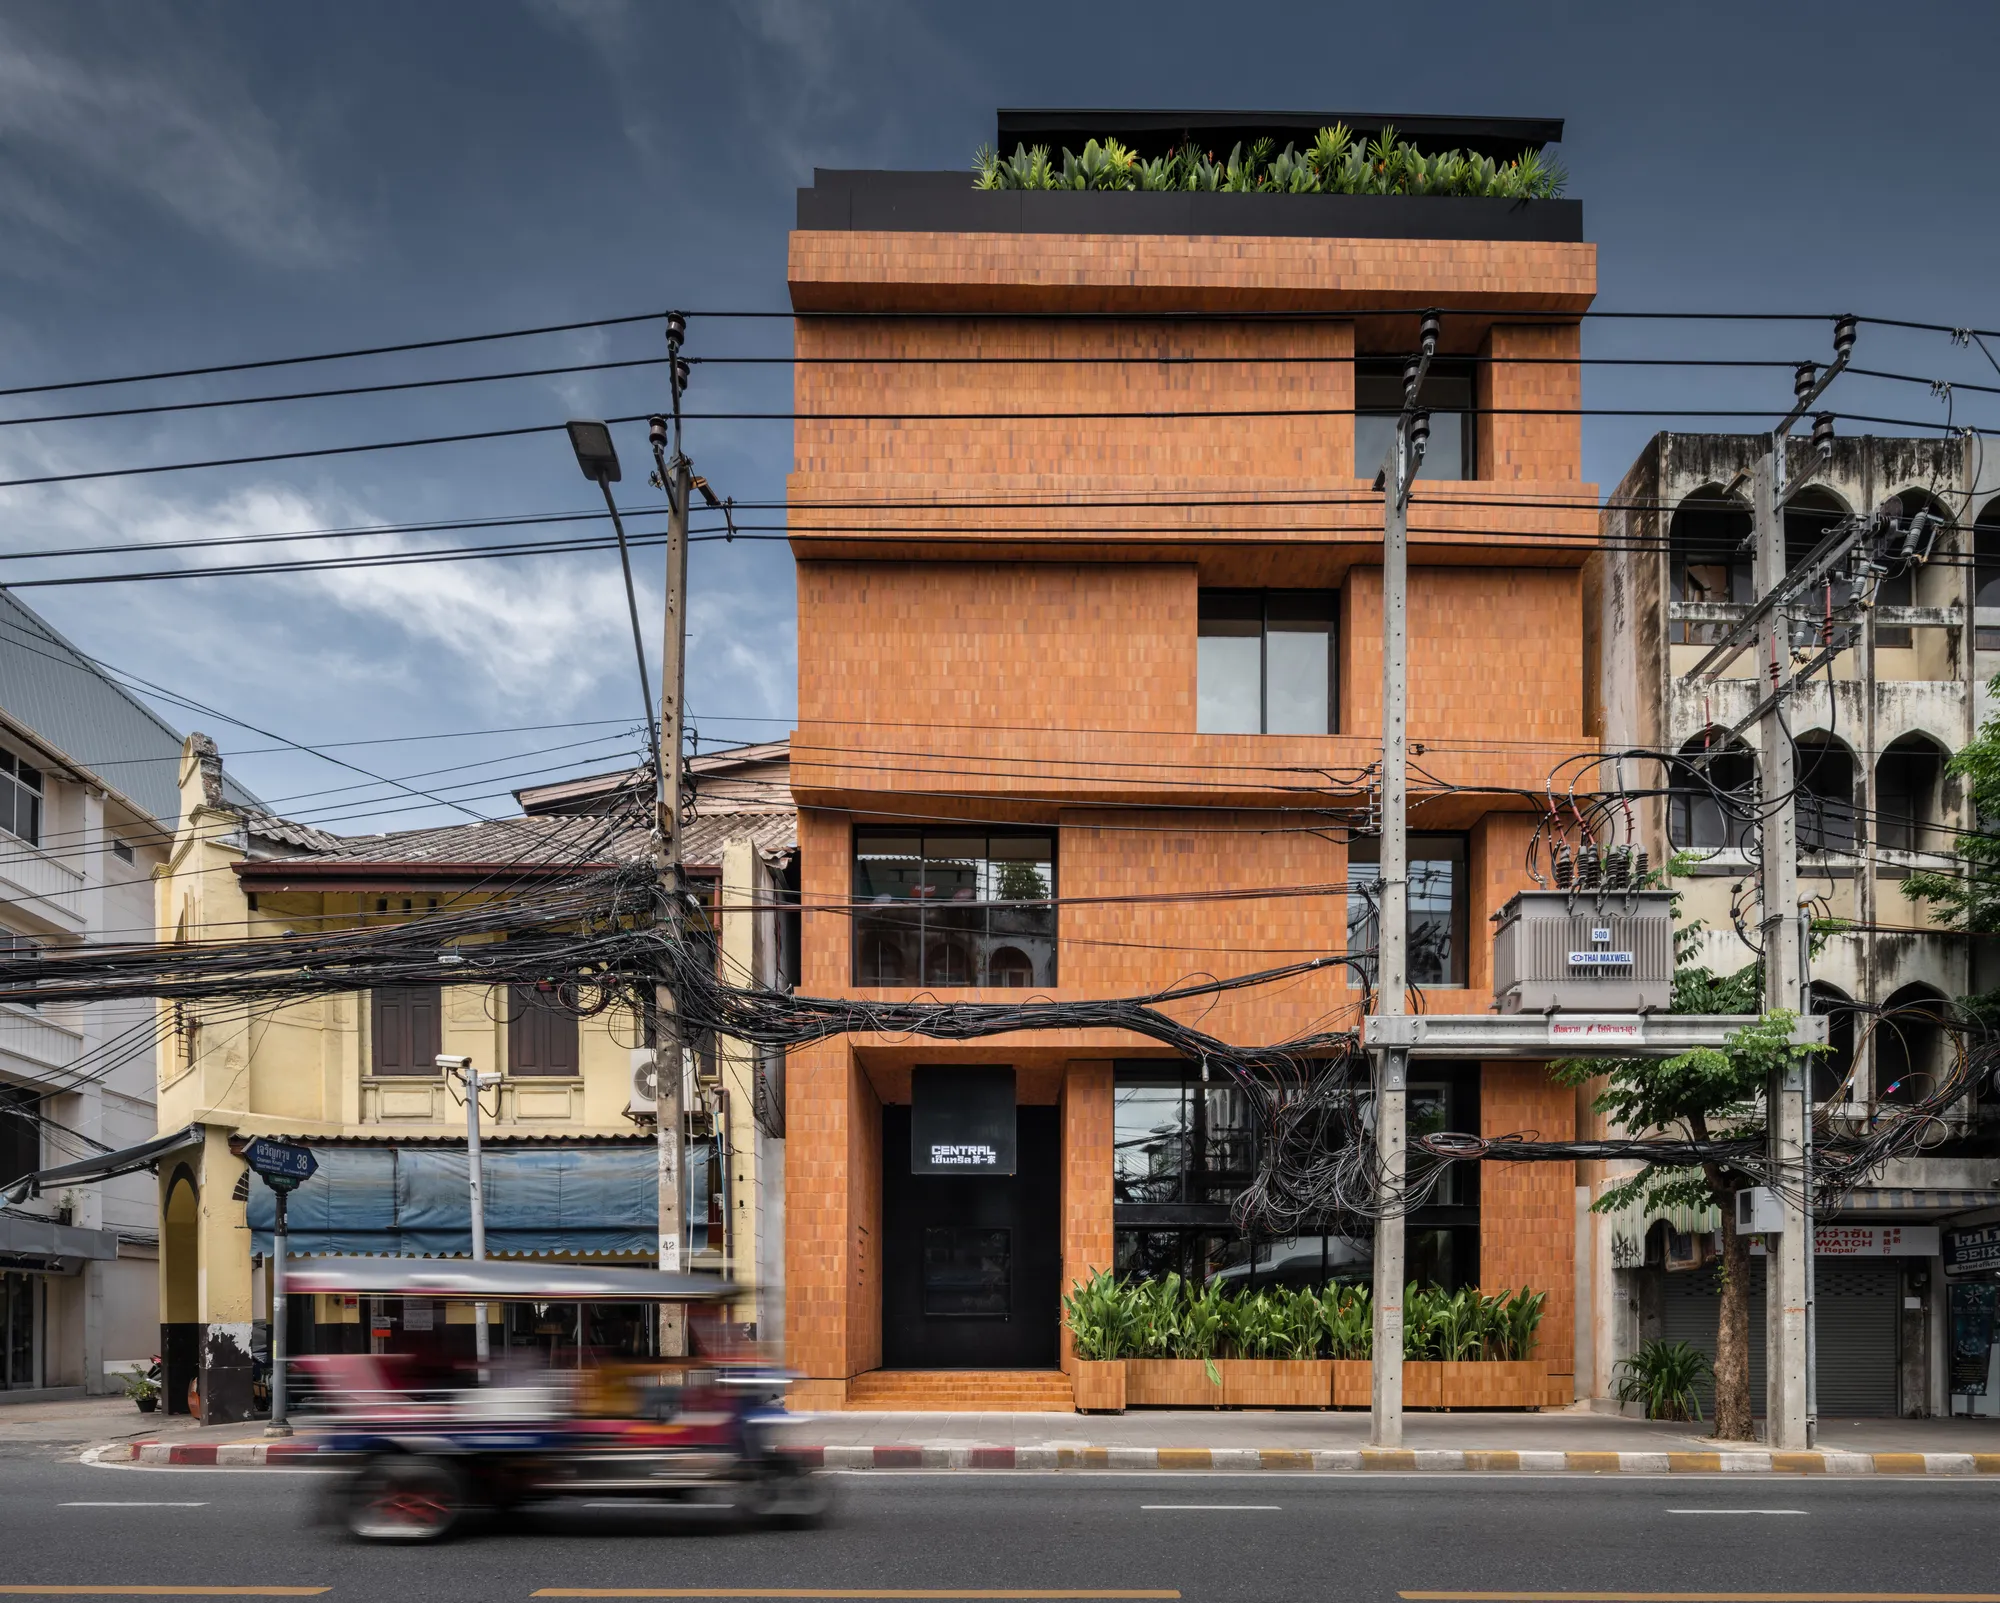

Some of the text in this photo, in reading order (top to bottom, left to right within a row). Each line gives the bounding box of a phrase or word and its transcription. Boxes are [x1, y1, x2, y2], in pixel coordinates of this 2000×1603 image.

[1594, 931, 1607, 939] 500
[1584, 954, 1631, 962] THAI MAXWELL
[931, 1145, 996, 1155] CENTRAL
[256, 1143, 290, 1163] เจริญกรุง
[296, 1154, 308, 1170] 38
[662, 1241, 675, 1250] 42
[1815, 1239, 1872, 1247] WATCH
[1824, 1247, 1857, 1255] Repair
